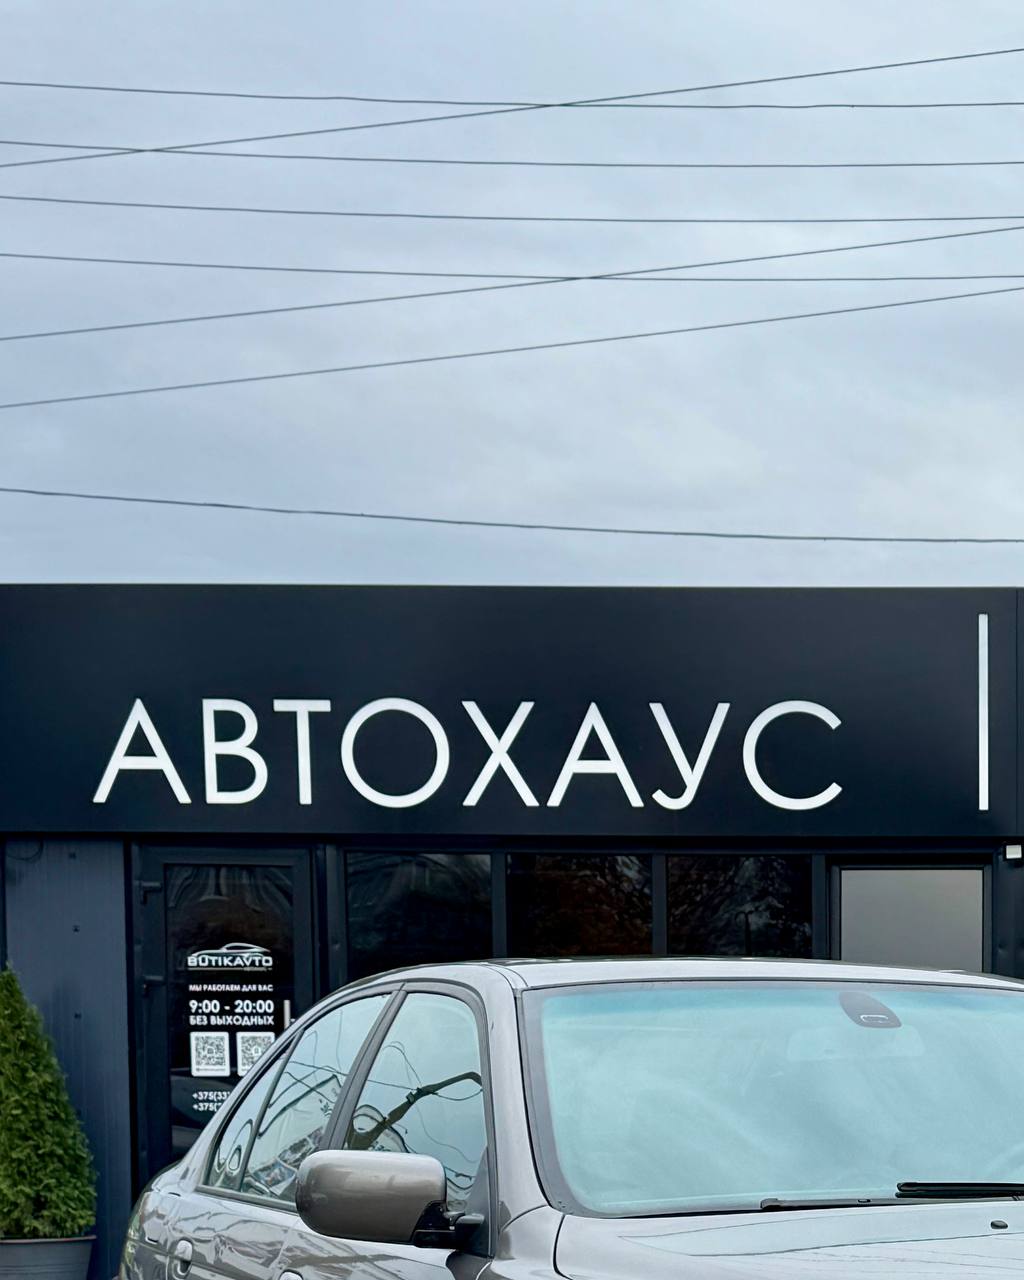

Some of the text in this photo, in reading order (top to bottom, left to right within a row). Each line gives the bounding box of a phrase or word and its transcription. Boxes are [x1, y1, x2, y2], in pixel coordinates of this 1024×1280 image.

[93, 698, 844, 810] АВТОХАУС
[187, 955, 273, 967] BUTIKAVTO
[203, 984, 240, 992] РАБОТАЕМ
[189, 1000, 220, 1013] 9:00
[234, 1000, 274, 1013] 20:00
[189, 1015, 274, 1026] БЕЗ ВЫХОДНЫХ
